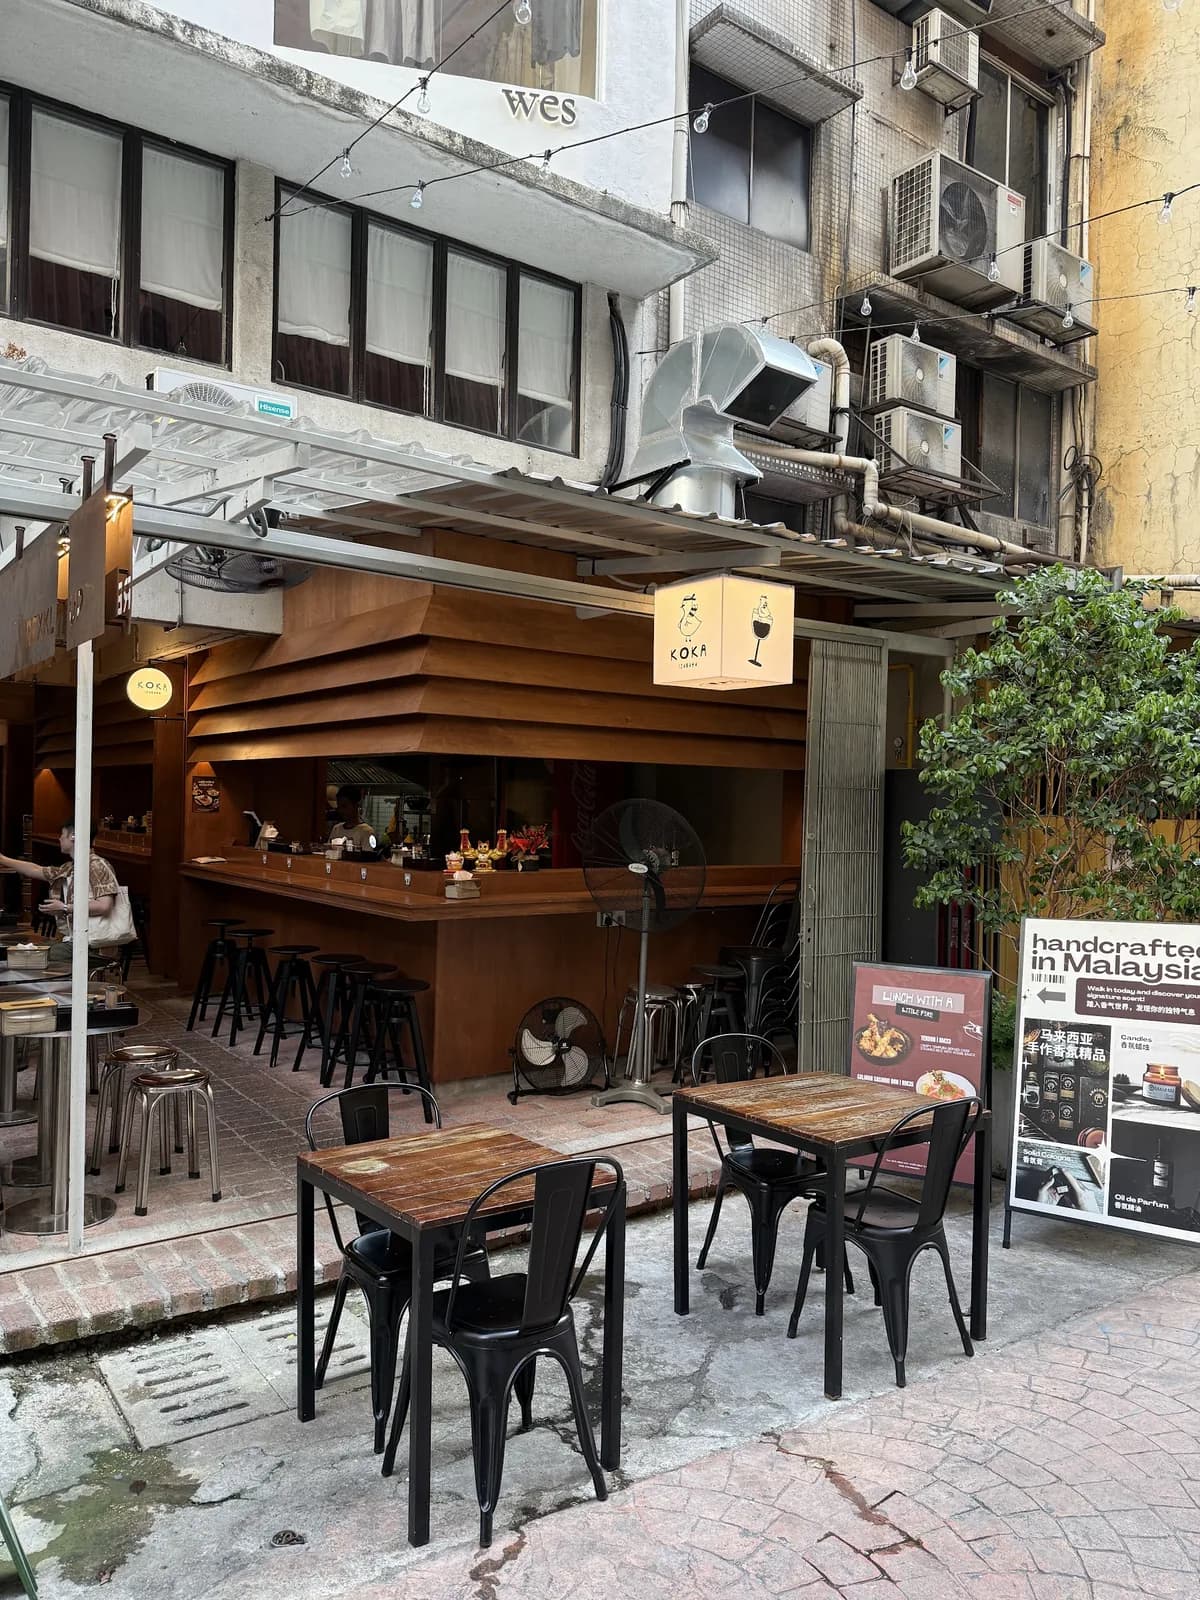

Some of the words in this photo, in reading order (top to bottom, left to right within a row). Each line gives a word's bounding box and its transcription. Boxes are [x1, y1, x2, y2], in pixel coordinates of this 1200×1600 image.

[502, 89, 576, 125] wes
[260, 402, 290, 415] Hisense
[670, 644, 707, 661] KOKA
[1033, 933, 1200, 958] handcrafte
[1032, 950, 1056, 971] in
[882, 991, 914, 1004] LUNCH
[916, 995, 943, 1007] WITH
[945, 997, 953, 1009] A
[1086, 992, 1121, 1001] signature
[1113, 987, 1136, 996] today
[1151, 990, 1184, 999] discover
[1040, 1028, 1093, 1046] 马来西亚
[1121, 1034, 1152, 1043] Candles
[1026, 1042, 1106, 1062] 手作香氛精品
[1137, 1197, 1169, 1209] Parfum
